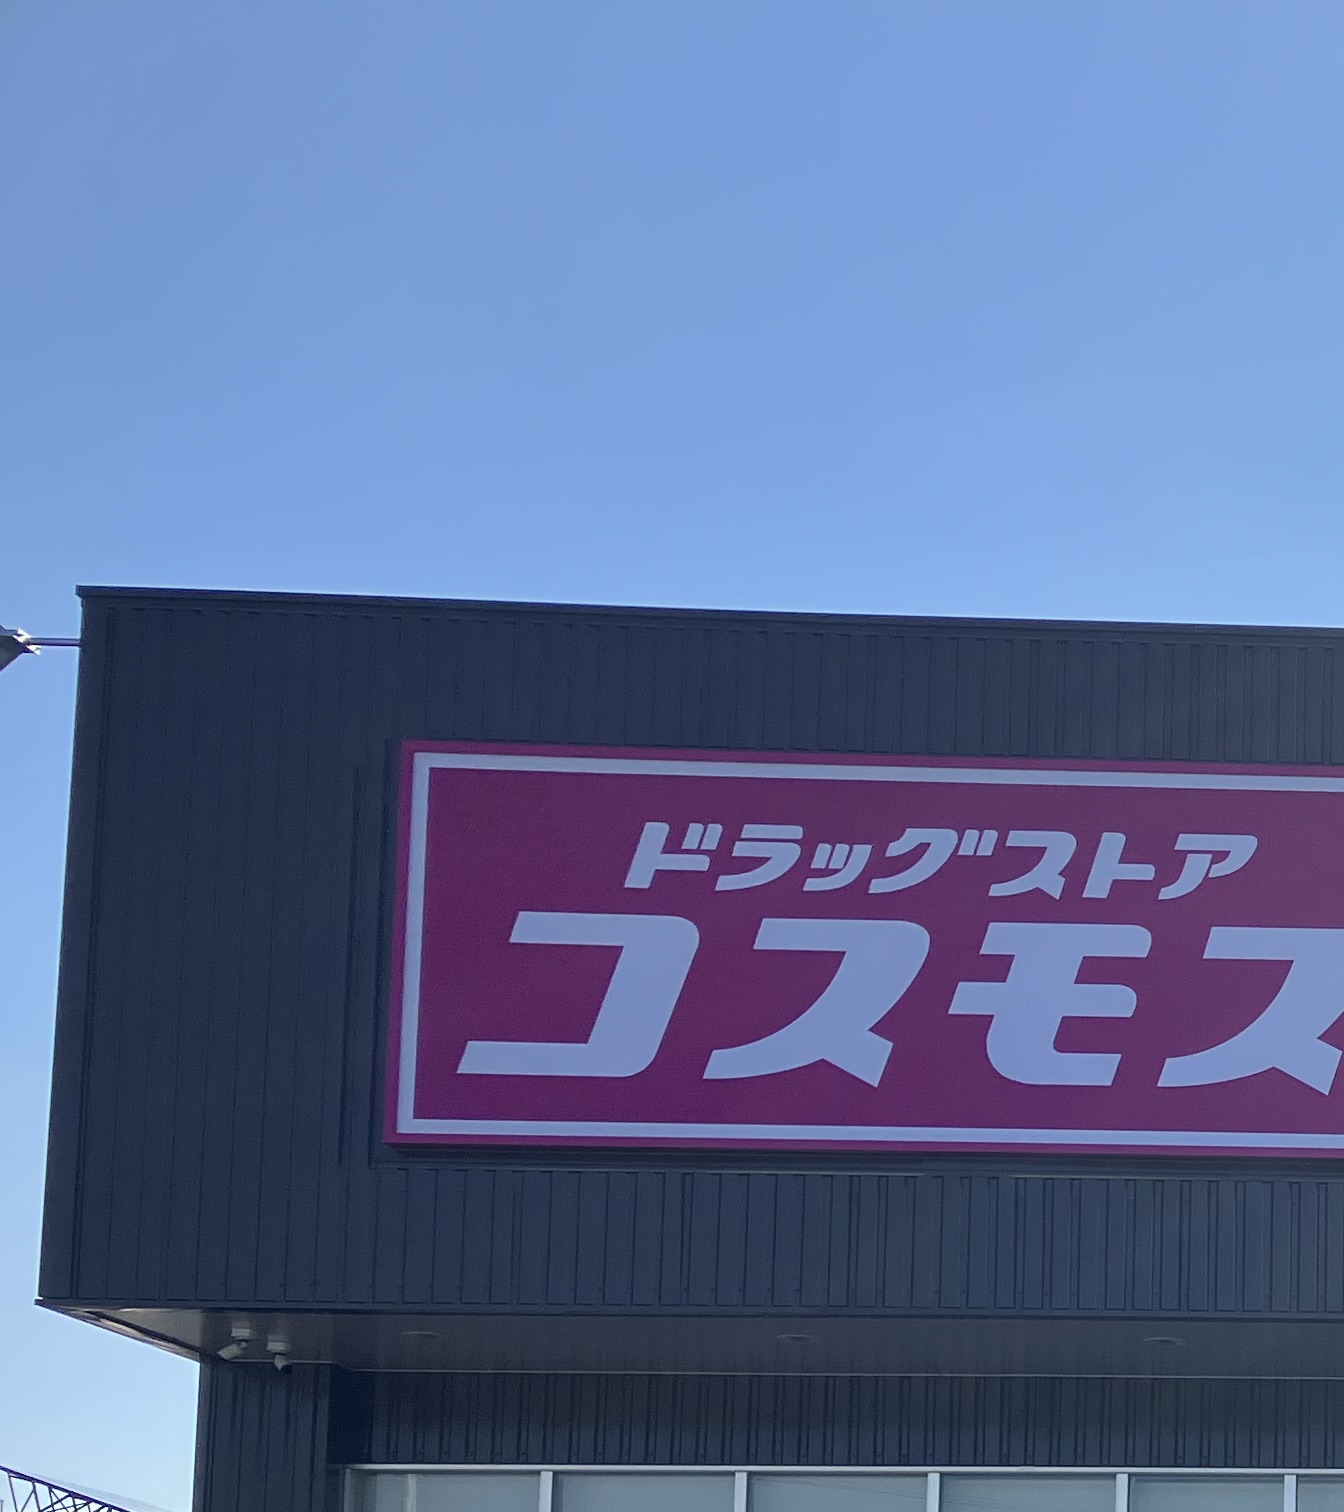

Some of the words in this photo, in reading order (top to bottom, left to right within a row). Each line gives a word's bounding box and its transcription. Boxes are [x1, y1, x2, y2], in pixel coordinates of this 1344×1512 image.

[623, 821, 1258, 901] ドラッグストア
